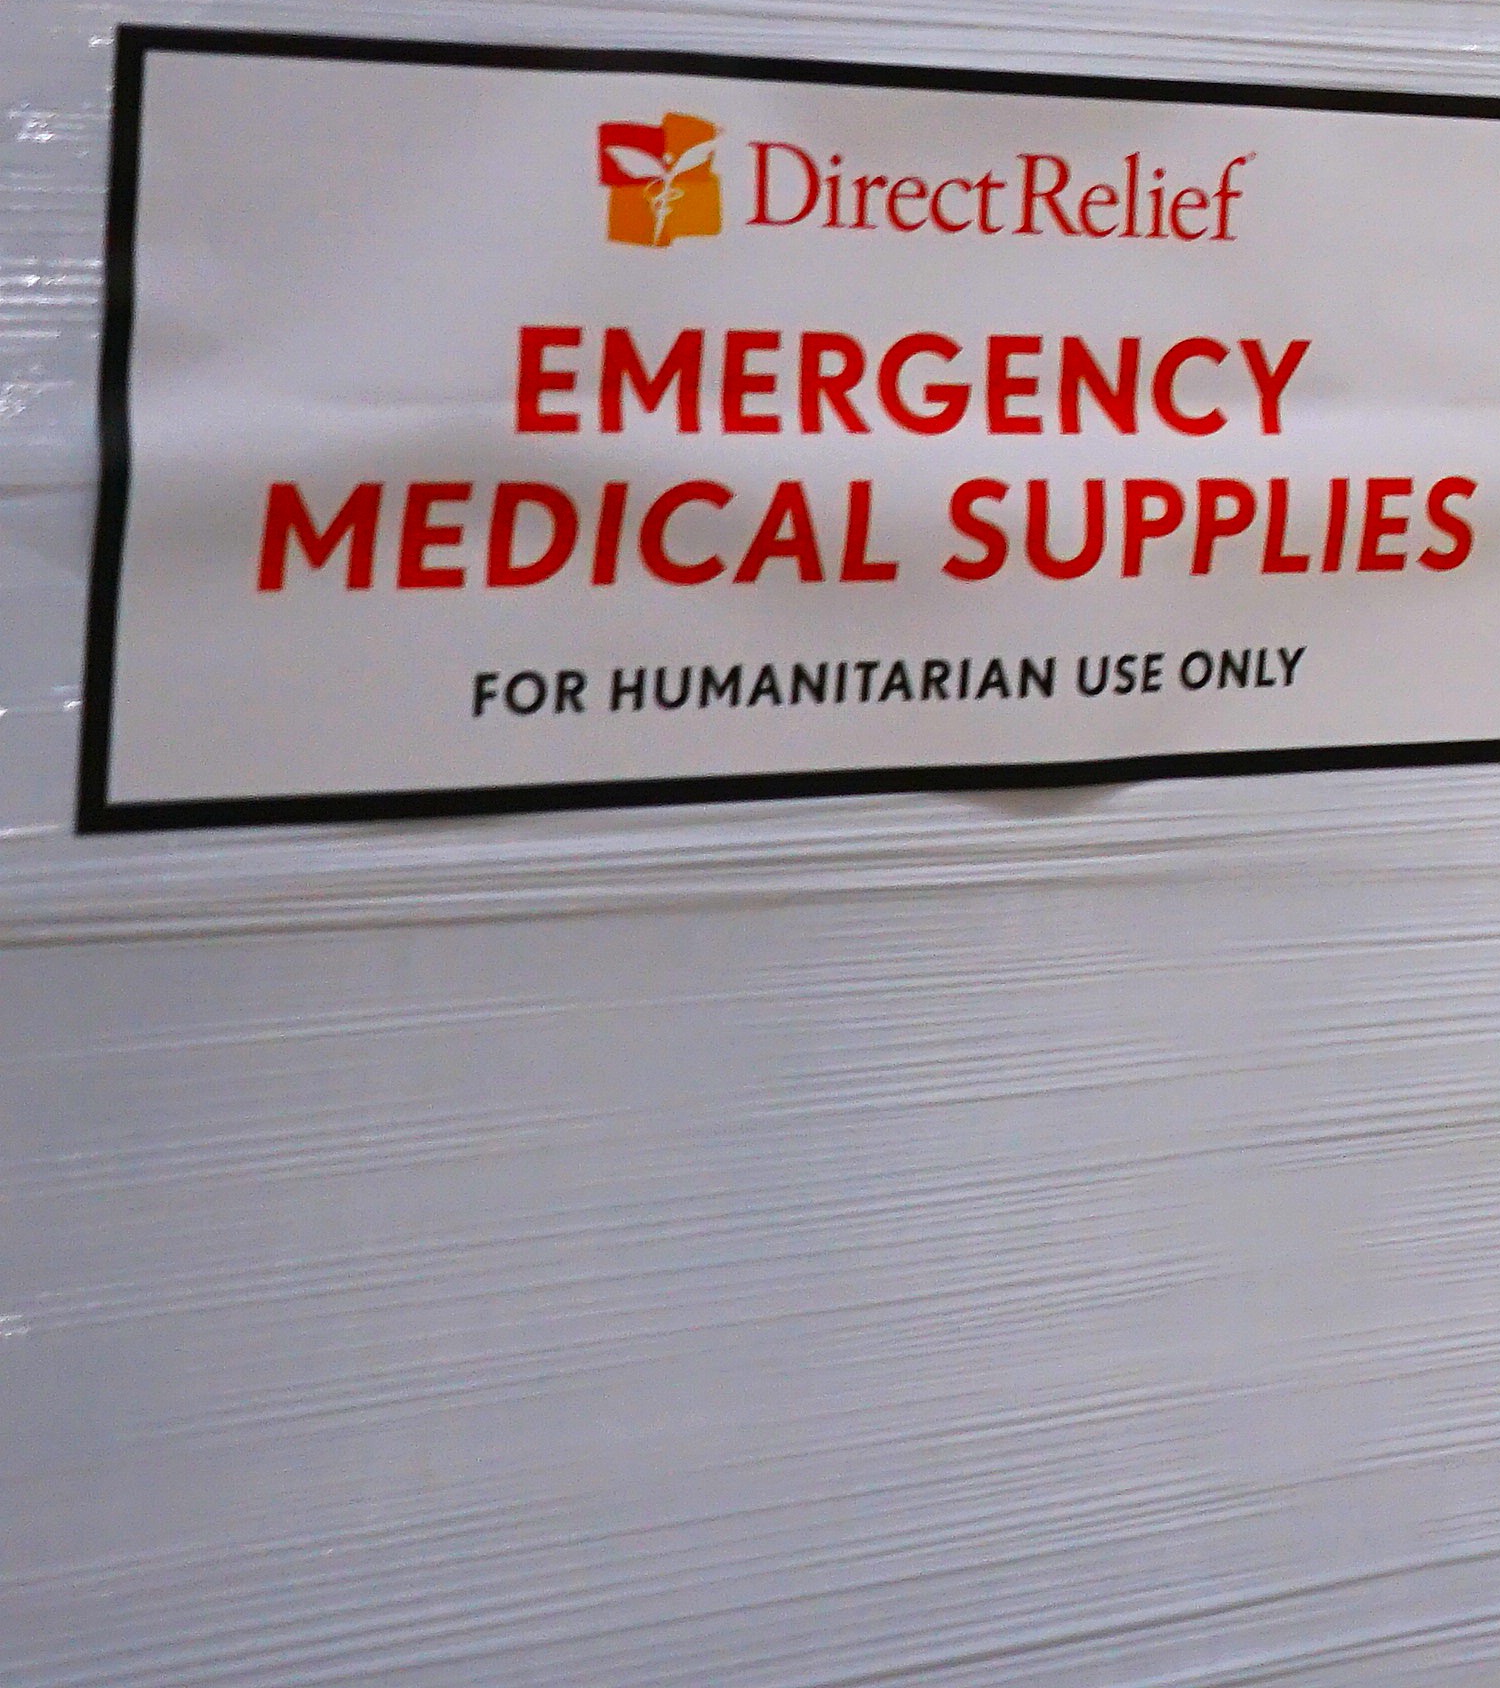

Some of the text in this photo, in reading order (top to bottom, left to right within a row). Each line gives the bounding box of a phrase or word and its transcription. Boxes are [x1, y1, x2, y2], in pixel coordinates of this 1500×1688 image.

[746, 139, 1248, 243] Direct Relief
[513, 324, 1312, 438] EMERGENCY
[255, 475, 1479, 594] MEDICAL SUPPLIES
[471, 645, 1308, 718] FOR HUMANITARIAN USE ONLY
